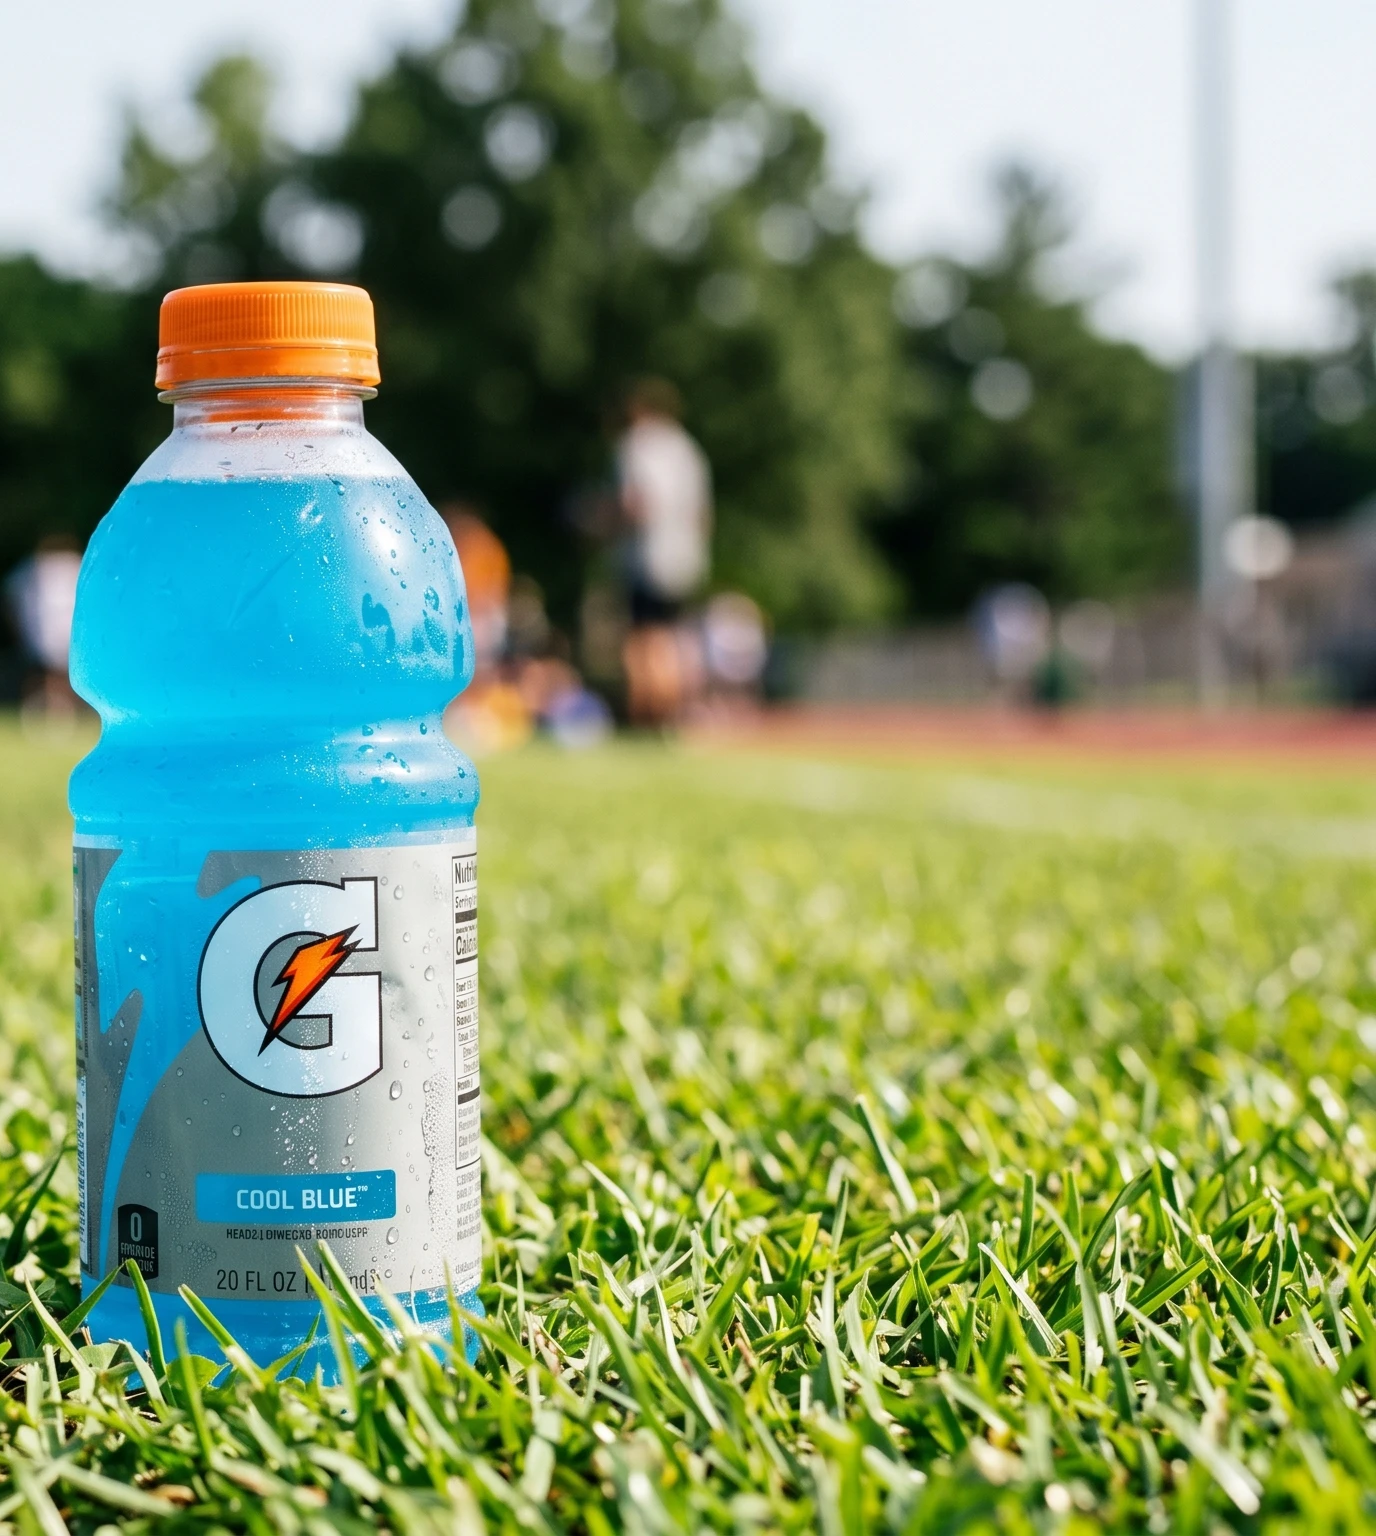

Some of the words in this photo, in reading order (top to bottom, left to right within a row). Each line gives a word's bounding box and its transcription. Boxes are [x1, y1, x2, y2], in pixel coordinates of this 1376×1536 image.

[197, 876, 383, 1099] G
[236, 1189, 295, 1210] COOL
[216, 1269, 239, 1291] 20
[246, 1270, 266, 1292] FL
[273, 1270, 297, 1292] OZ
